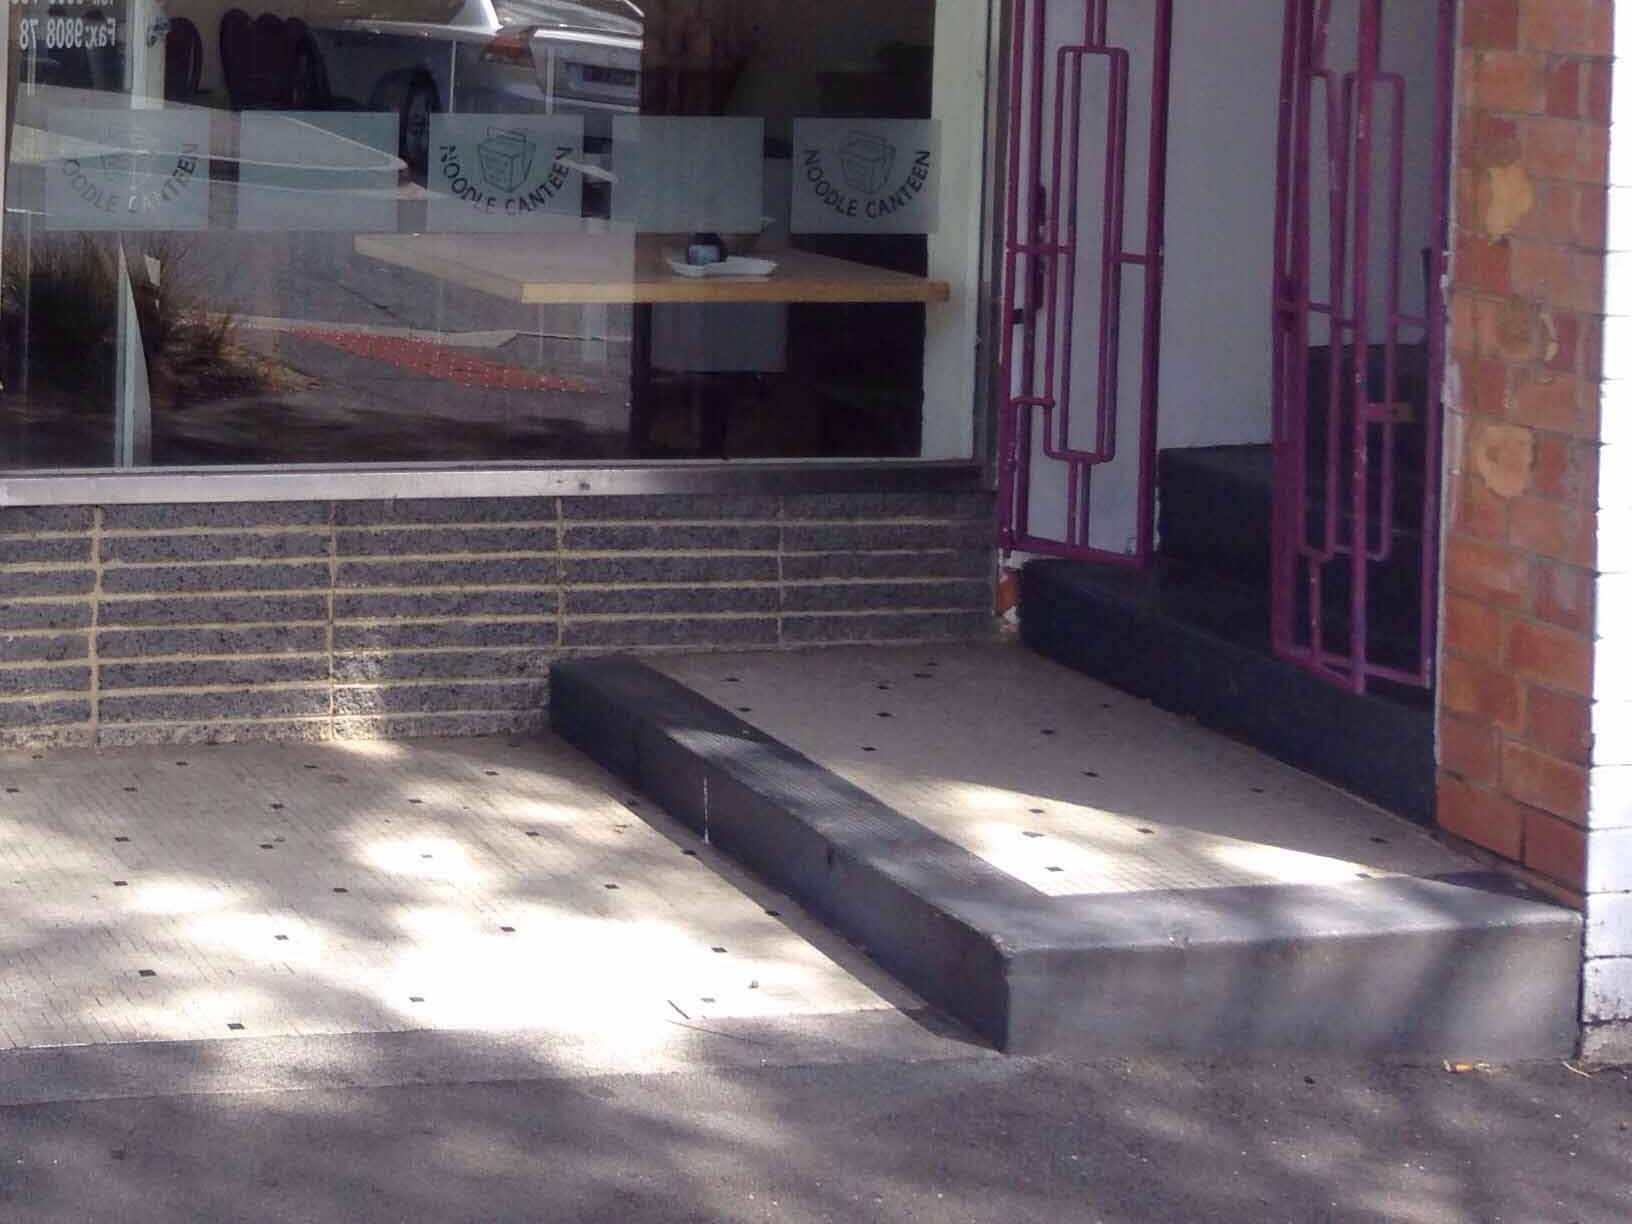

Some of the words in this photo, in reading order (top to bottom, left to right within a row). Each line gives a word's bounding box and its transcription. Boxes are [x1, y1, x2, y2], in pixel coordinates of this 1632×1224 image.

[439, 144, 497, 215] NOODLE
[505, 145, 574, 217] CANTEEN
[803, 148, 858, 217] NOODLE
[864, 149, 932, 219] CANTEEN
